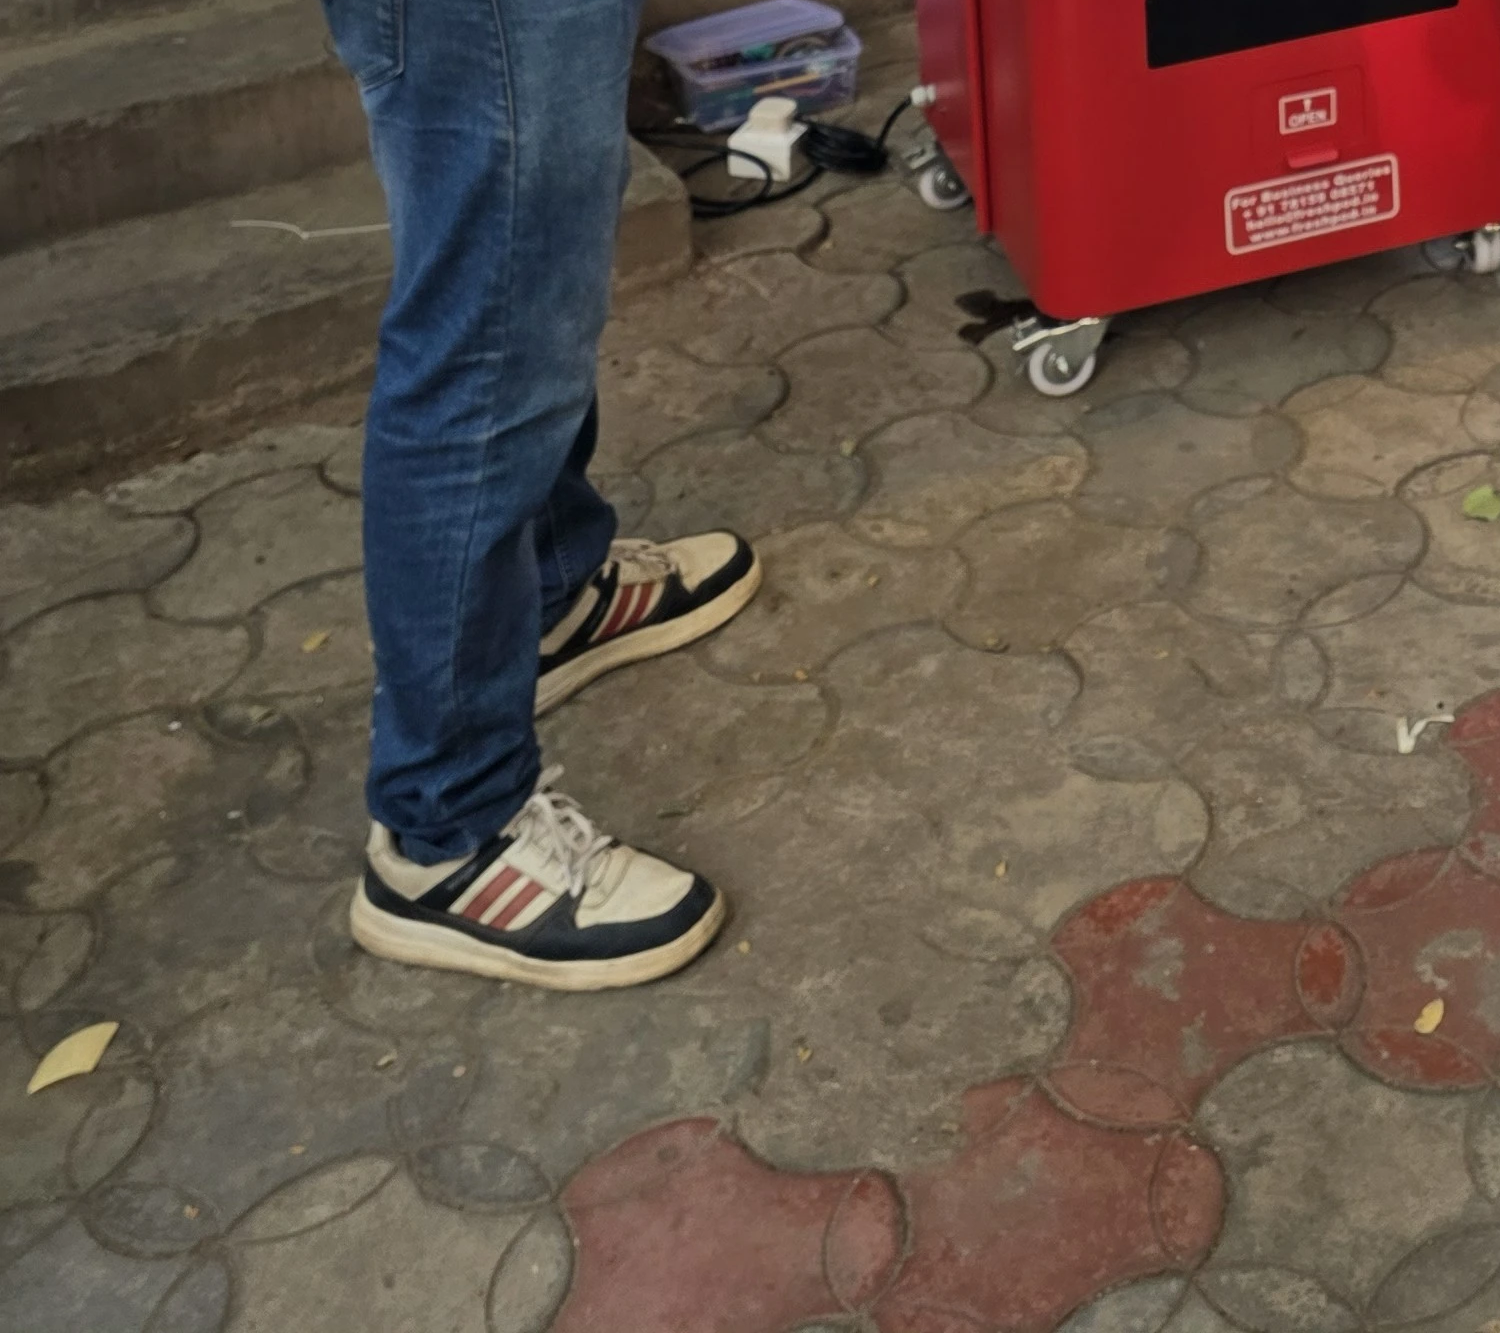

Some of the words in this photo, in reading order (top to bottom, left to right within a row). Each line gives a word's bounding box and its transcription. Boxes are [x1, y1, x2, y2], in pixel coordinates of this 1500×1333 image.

[1288, 110, 1327, 127] OPEN
[1260, 180, 1330, 203] Business
[1333, 165, 1391, 186] Queries
